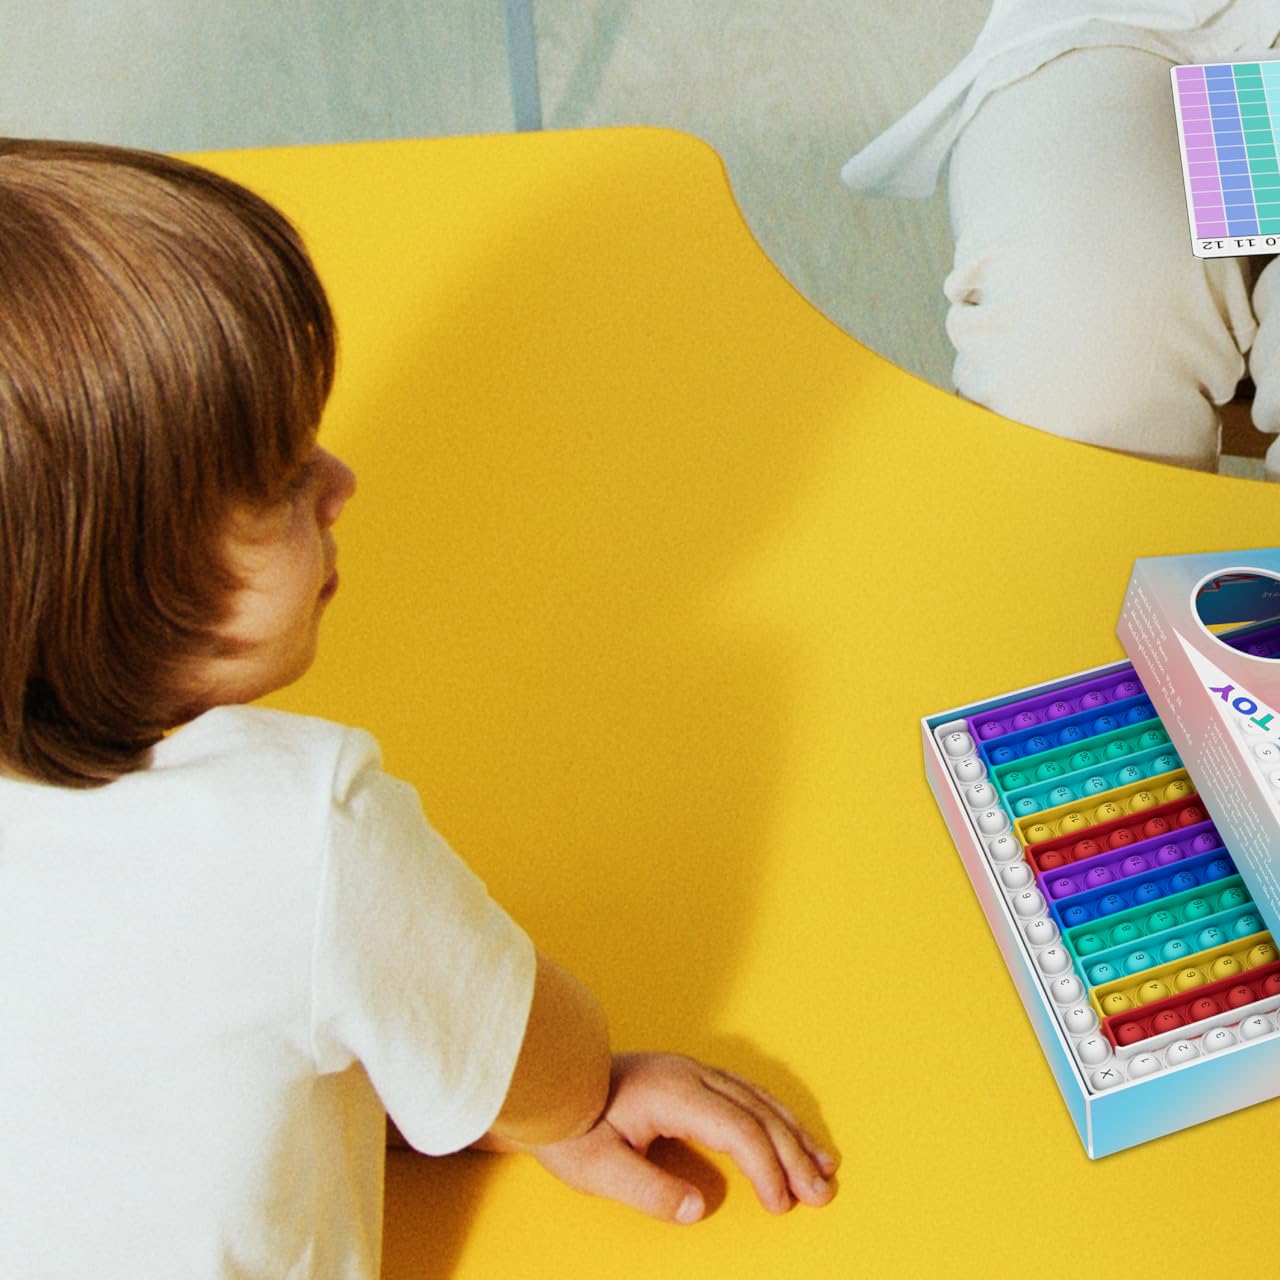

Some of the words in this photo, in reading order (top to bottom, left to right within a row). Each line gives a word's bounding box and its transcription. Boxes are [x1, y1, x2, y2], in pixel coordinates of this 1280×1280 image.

[1201, 240, 1226, 250] 12
[1233, 238, 1256, 248] 11
[1207, 684, 1275, 732] TOY
[951, 732, 961, 742] 12
[962, 758, 973, 768] 11
[973, 783, 985, 793] 10
[1035, 920, 1044, 928] 5
[1060, 978, 1070, 986] 3
[1073, 1008, 1084, 1016] 2
[1178, 1044, 1189, 1052] 2
